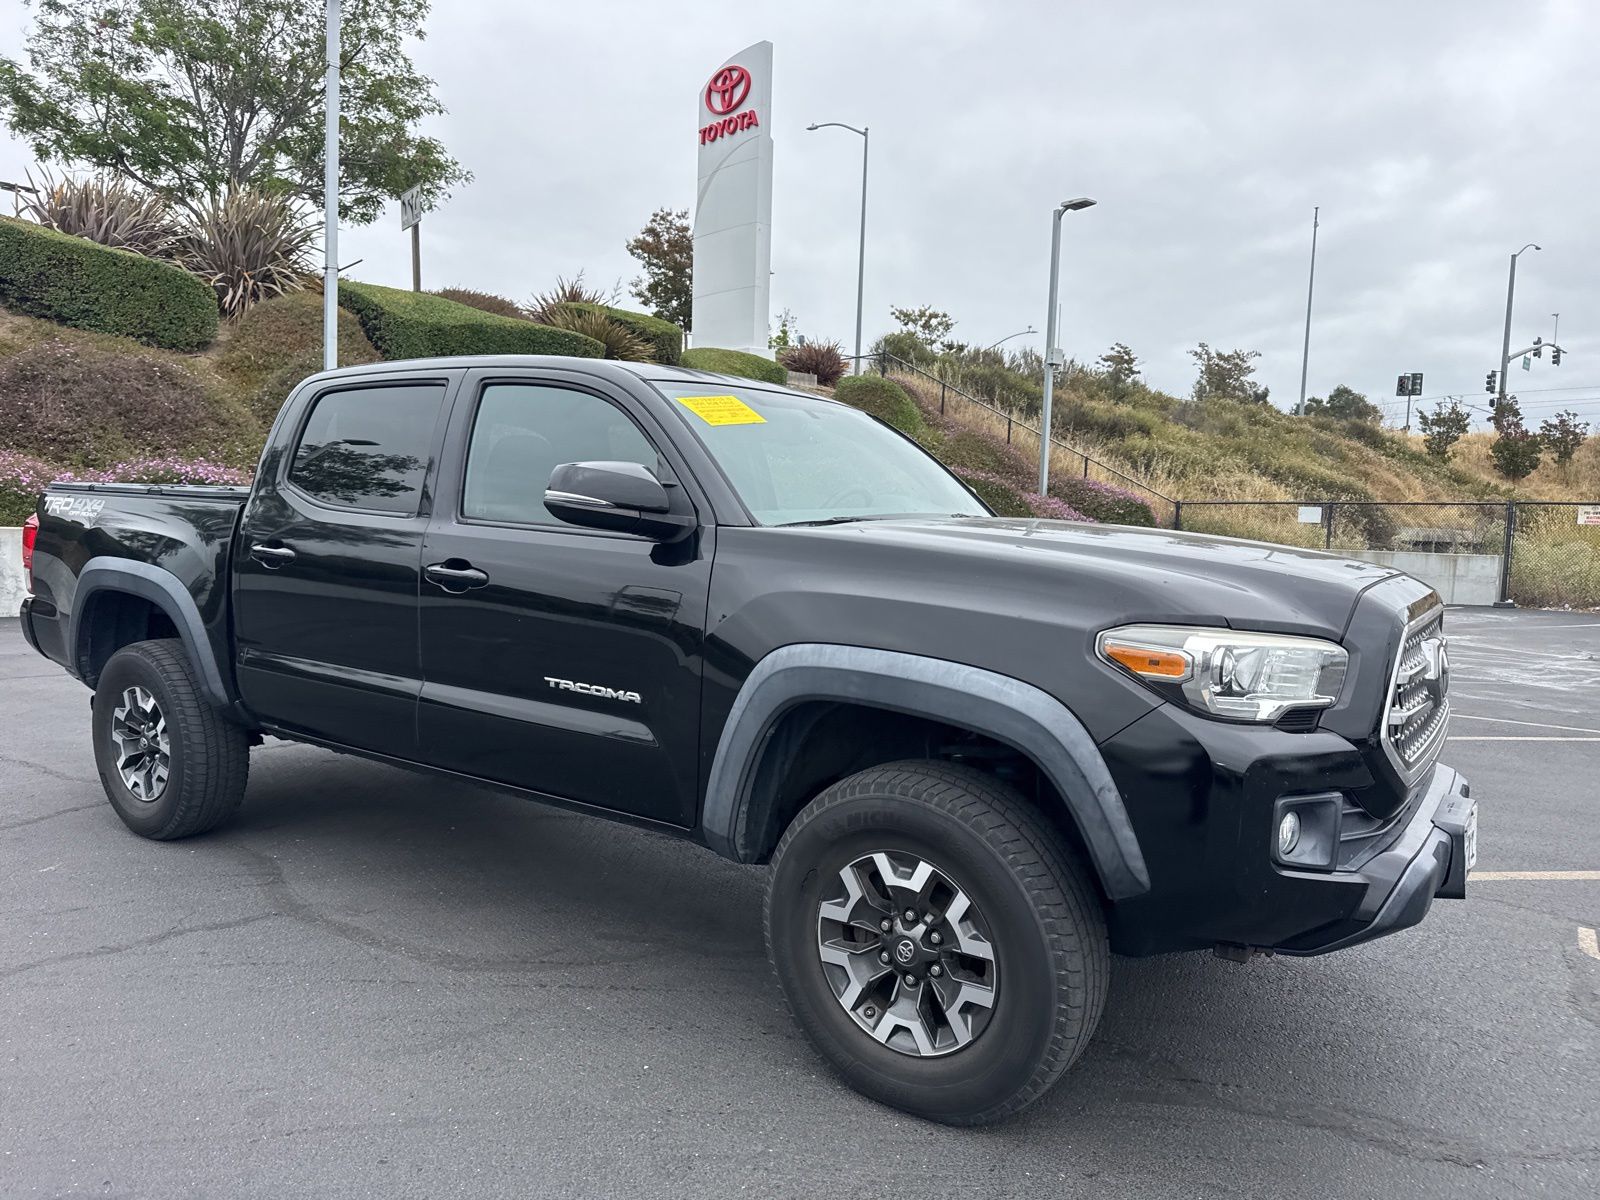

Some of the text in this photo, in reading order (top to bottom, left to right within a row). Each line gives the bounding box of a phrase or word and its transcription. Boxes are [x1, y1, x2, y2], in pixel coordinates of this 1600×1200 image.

[699, 110, 759, 145] TOYOTA
[44, 497, 74, 513] TRD
[544, 676, 642, 703] TACOMA
